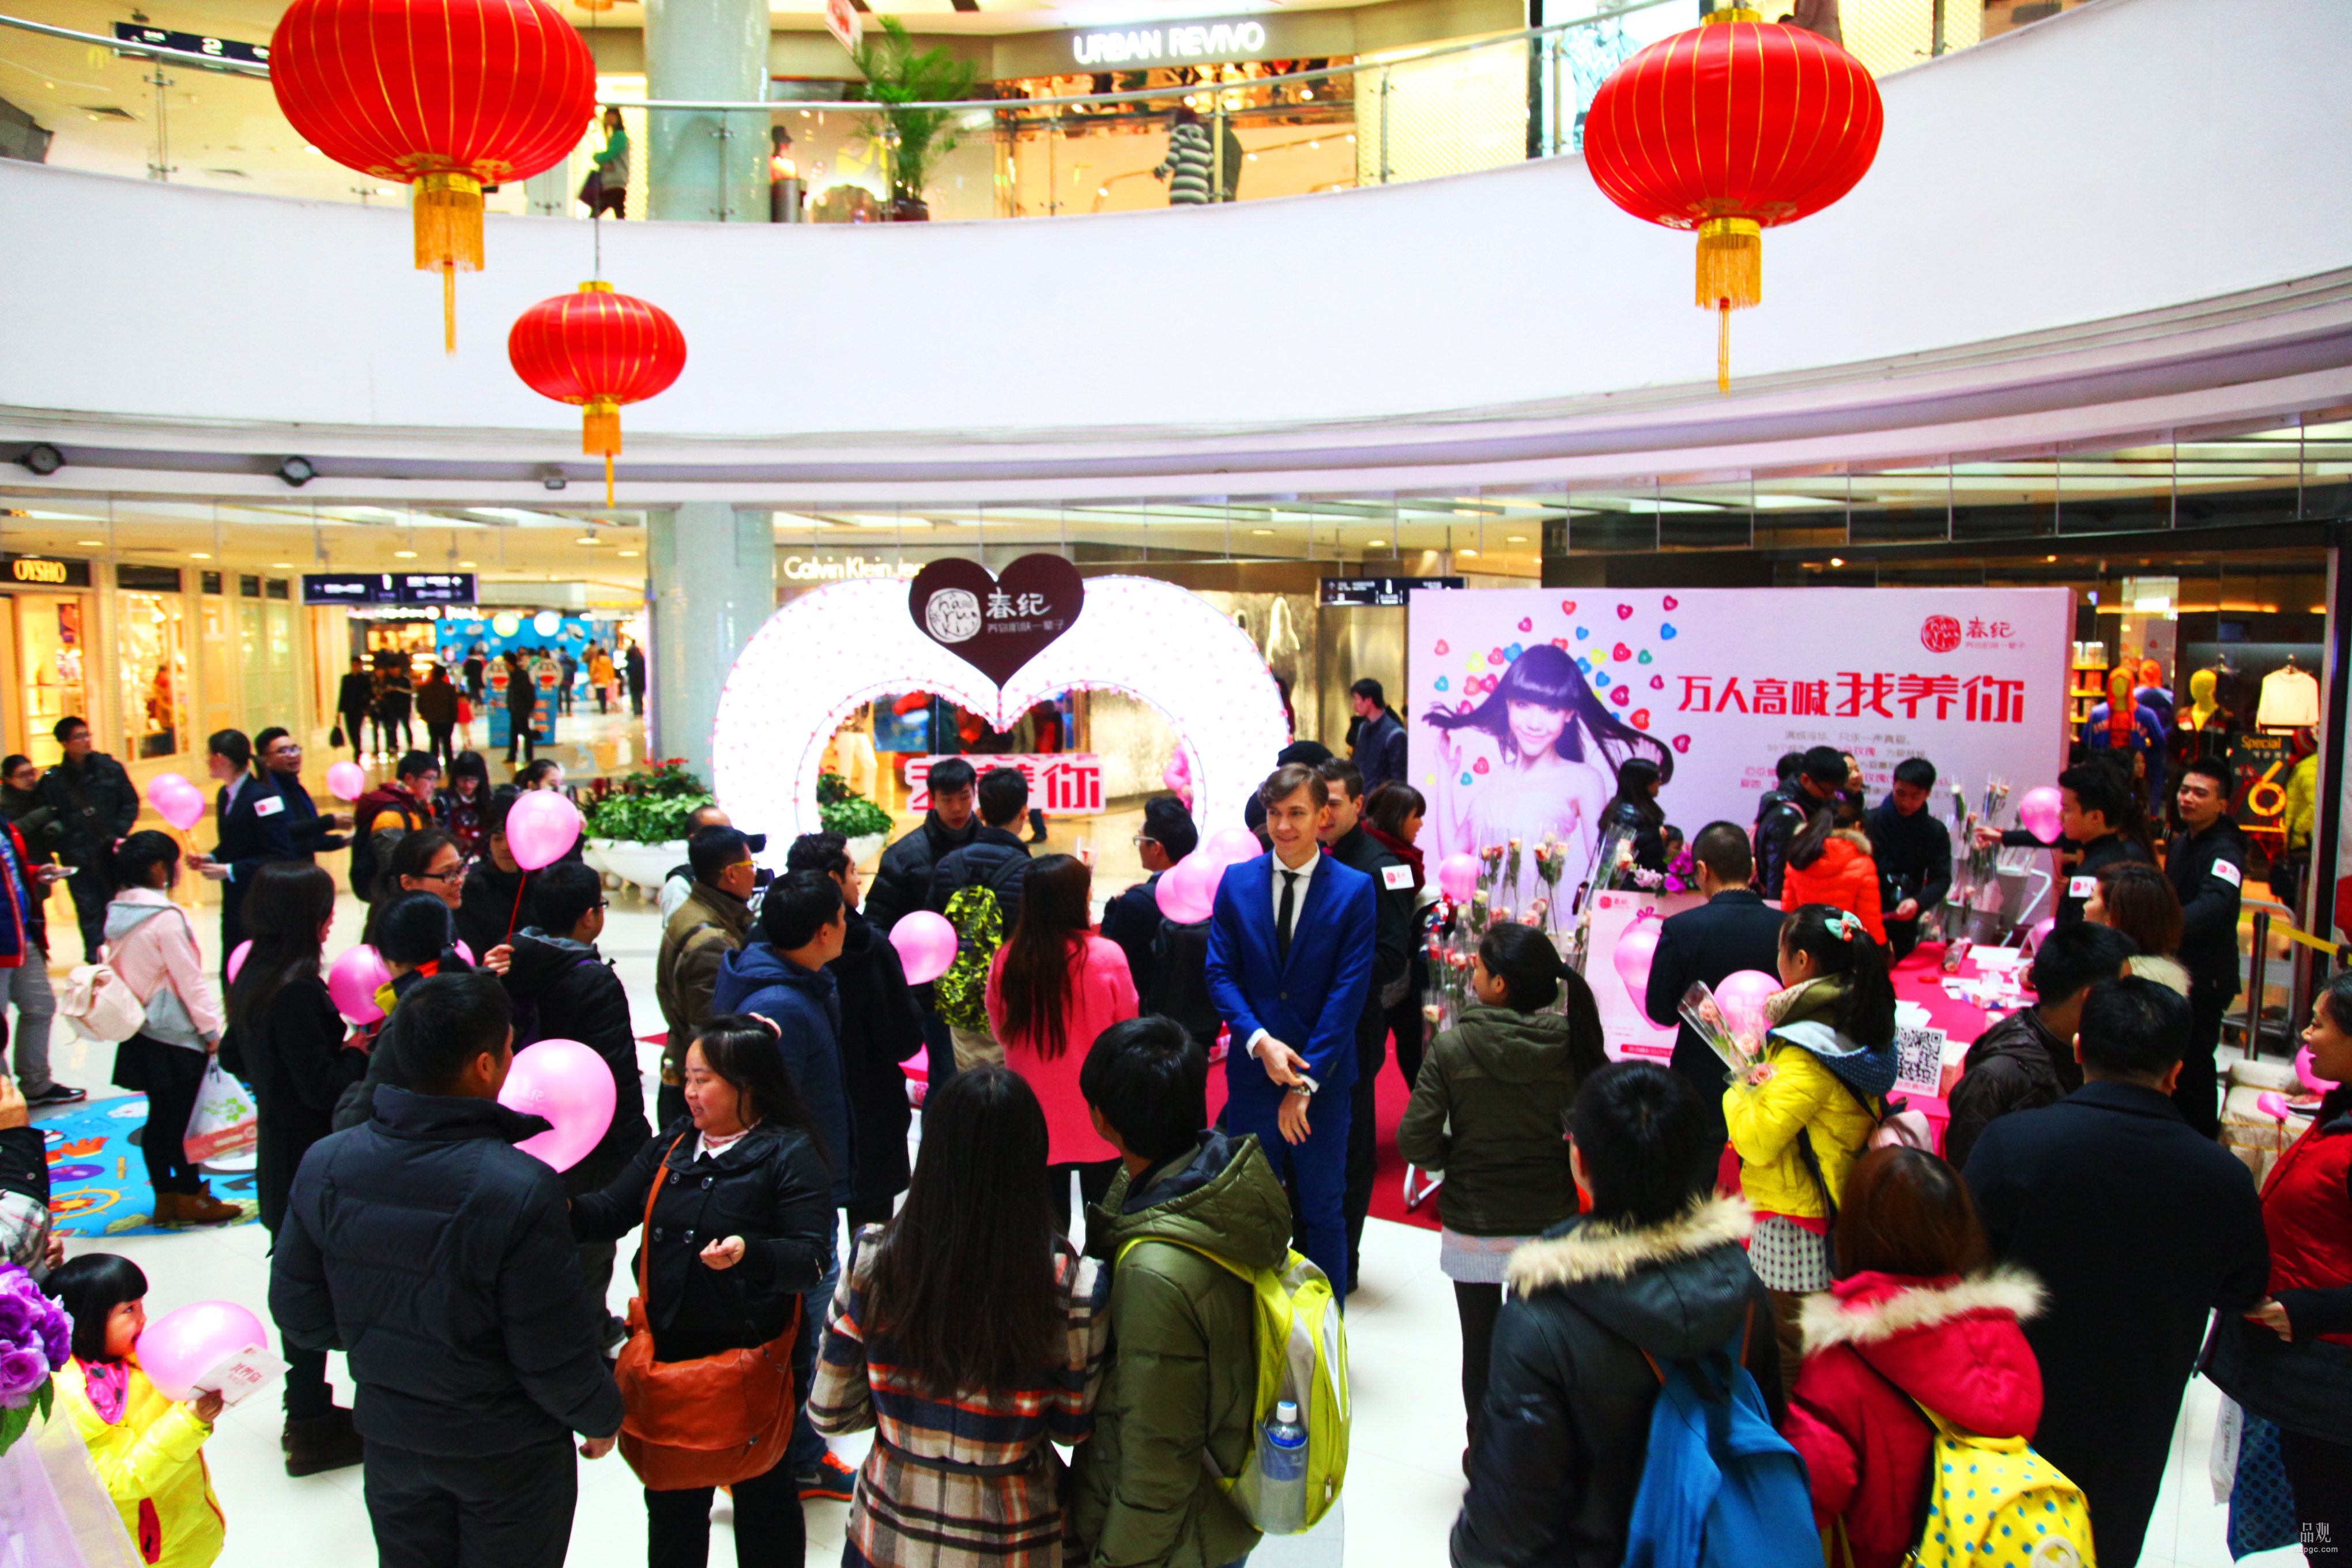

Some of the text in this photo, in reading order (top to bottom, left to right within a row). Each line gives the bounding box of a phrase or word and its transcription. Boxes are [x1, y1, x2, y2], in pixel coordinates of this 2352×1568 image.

[202, 37, 223, 55] 2
[1074, 21, 1265, 64] URBAN REVIVO
[13, 559, 67, 583] OYSHO
[784, 556, 844, 579] Calvin
[846, 556, 891, 579] Klein
[986, 587, 1051, 619] 春纪
[1966, 616, 2015, 638] 春纪
[1678, 672, 2025, 723] 万人高喊我养你
[2241, 734, 2283, 750] Special
[2248, 760, 2287, 817] 6
